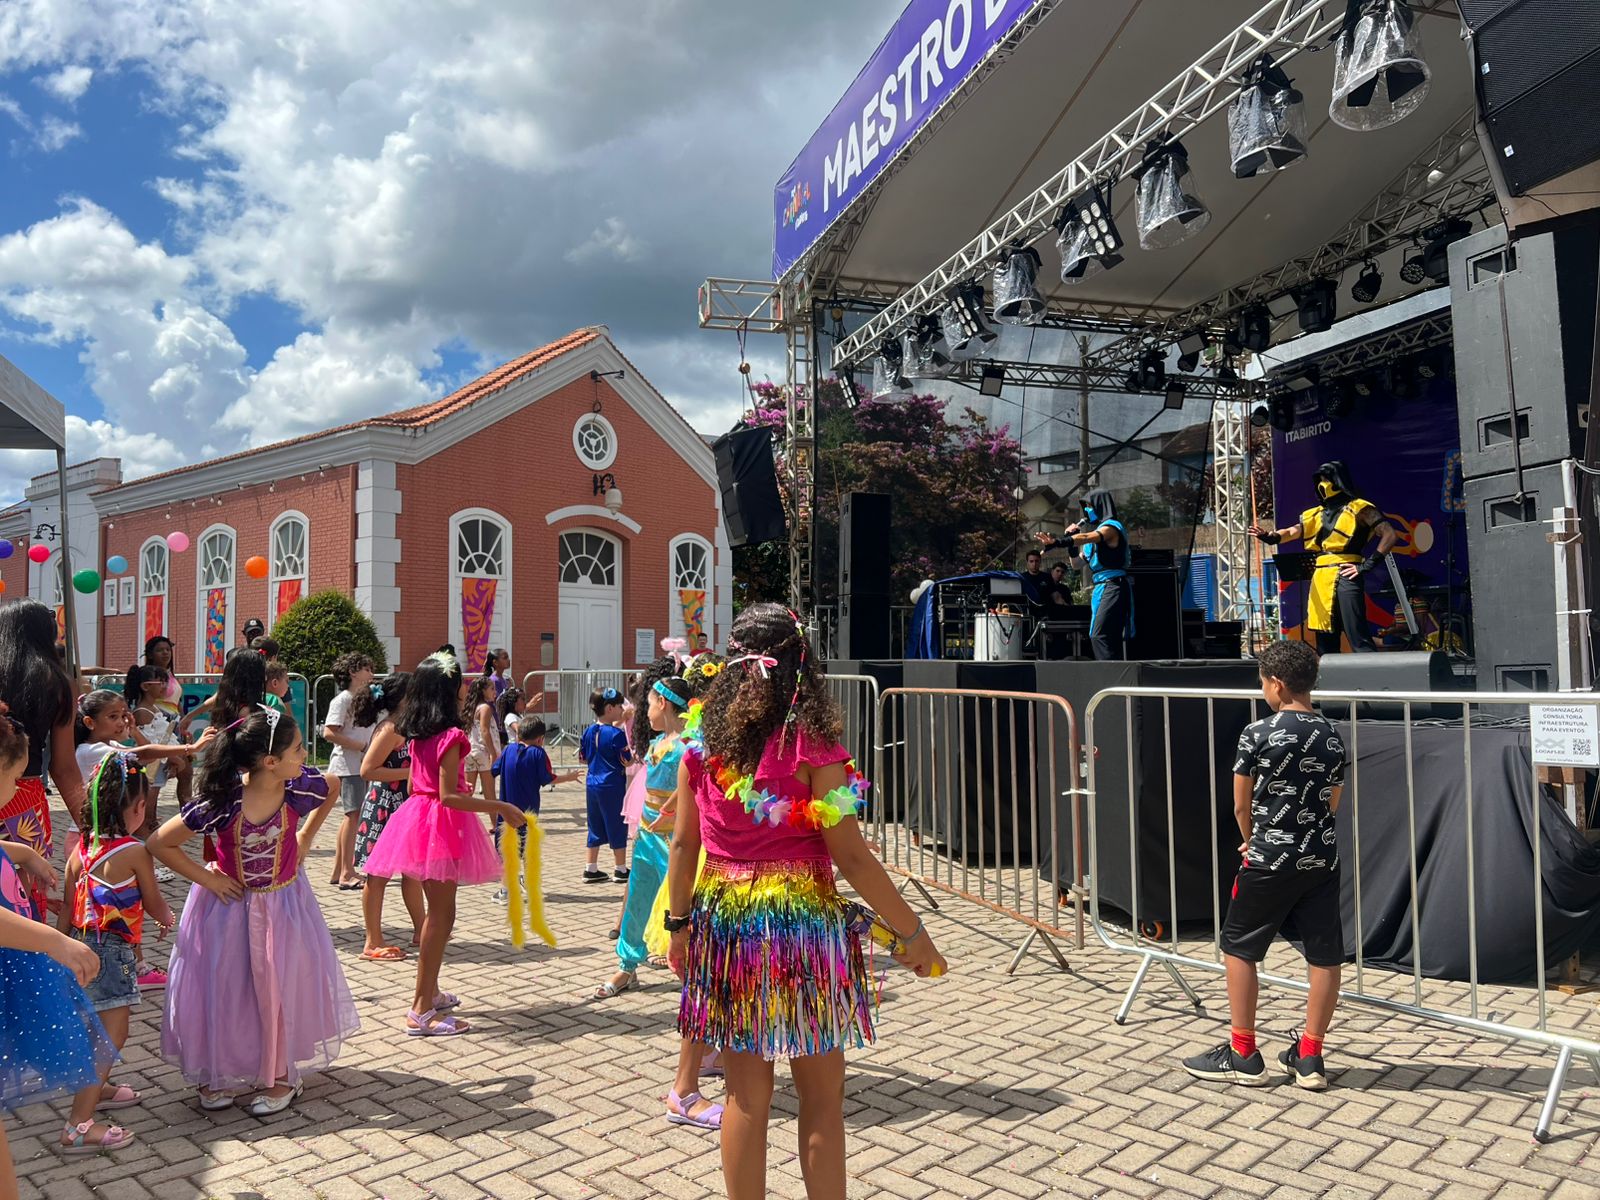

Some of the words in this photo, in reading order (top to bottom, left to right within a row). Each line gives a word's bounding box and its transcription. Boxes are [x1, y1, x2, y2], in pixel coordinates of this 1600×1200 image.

[823, 0, 972, 213] MAESTRO
[1285, 420, 1332, 444] ITABIRITO
[1300, 728, 1321, 753] LACOSTE
[1272, 752, 1295, 778] LACOSTE
[1298, 779, 1316, 805] LACOSTE
[1269, 803, 1291, 826] LACOSTE
[1297, 828, 1316, 853] LACOSTE
